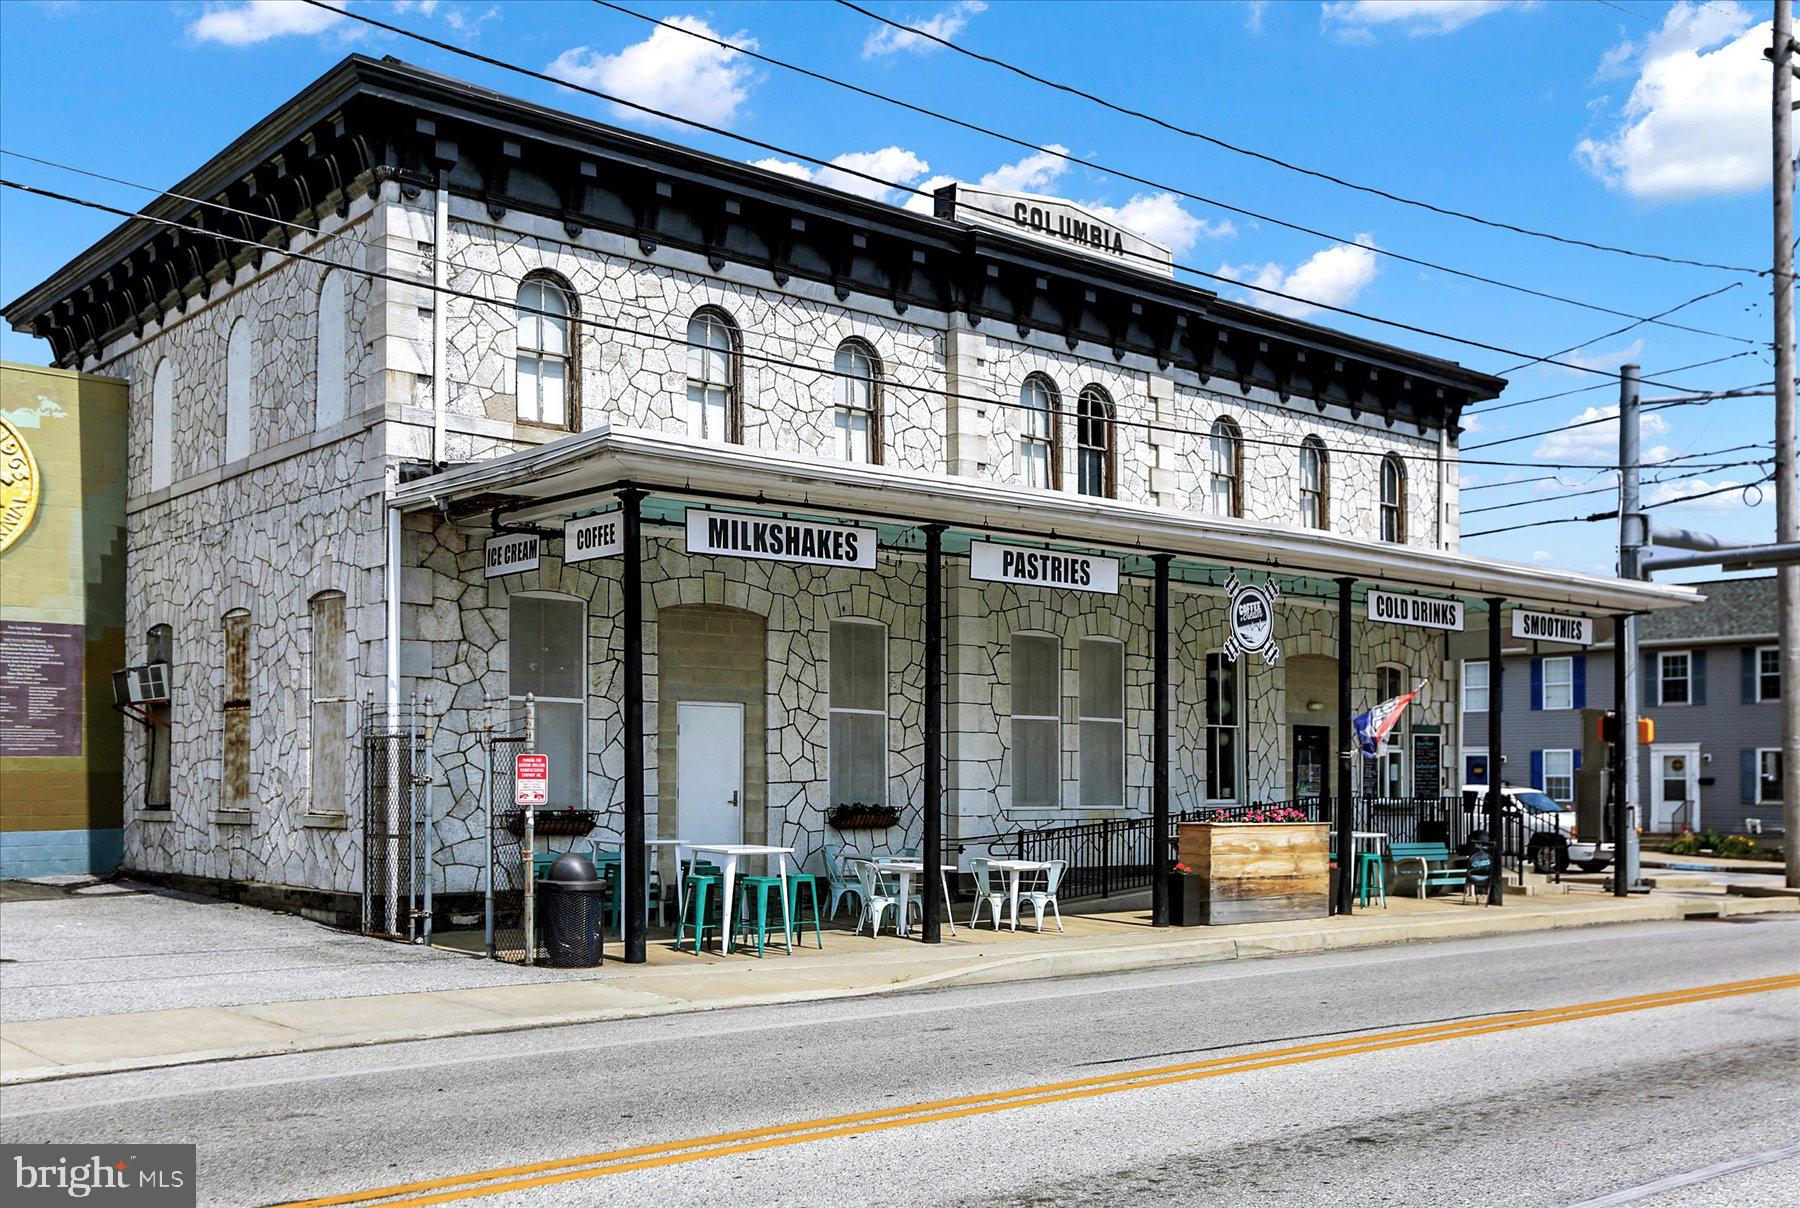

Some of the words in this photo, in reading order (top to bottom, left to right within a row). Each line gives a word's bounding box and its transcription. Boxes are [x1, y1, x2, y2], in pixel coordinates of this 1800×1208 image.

[1014, 202, 1124, 256] COLUMBIA
[577, 523, 615, 550] COFFEE
[708, 517, 858, 562] MILKSHAKES
[487, 546, 502, 567] ICE
[504, 539, 537, 564] CREAM
[1003, 550, 1090, 586] PASTRIES
[1376, 595, 1408, 620] COLD
[1412, 600, 1456, 626] DRINKS
[1523, 614, 1582, 640] SMOOTHIES
